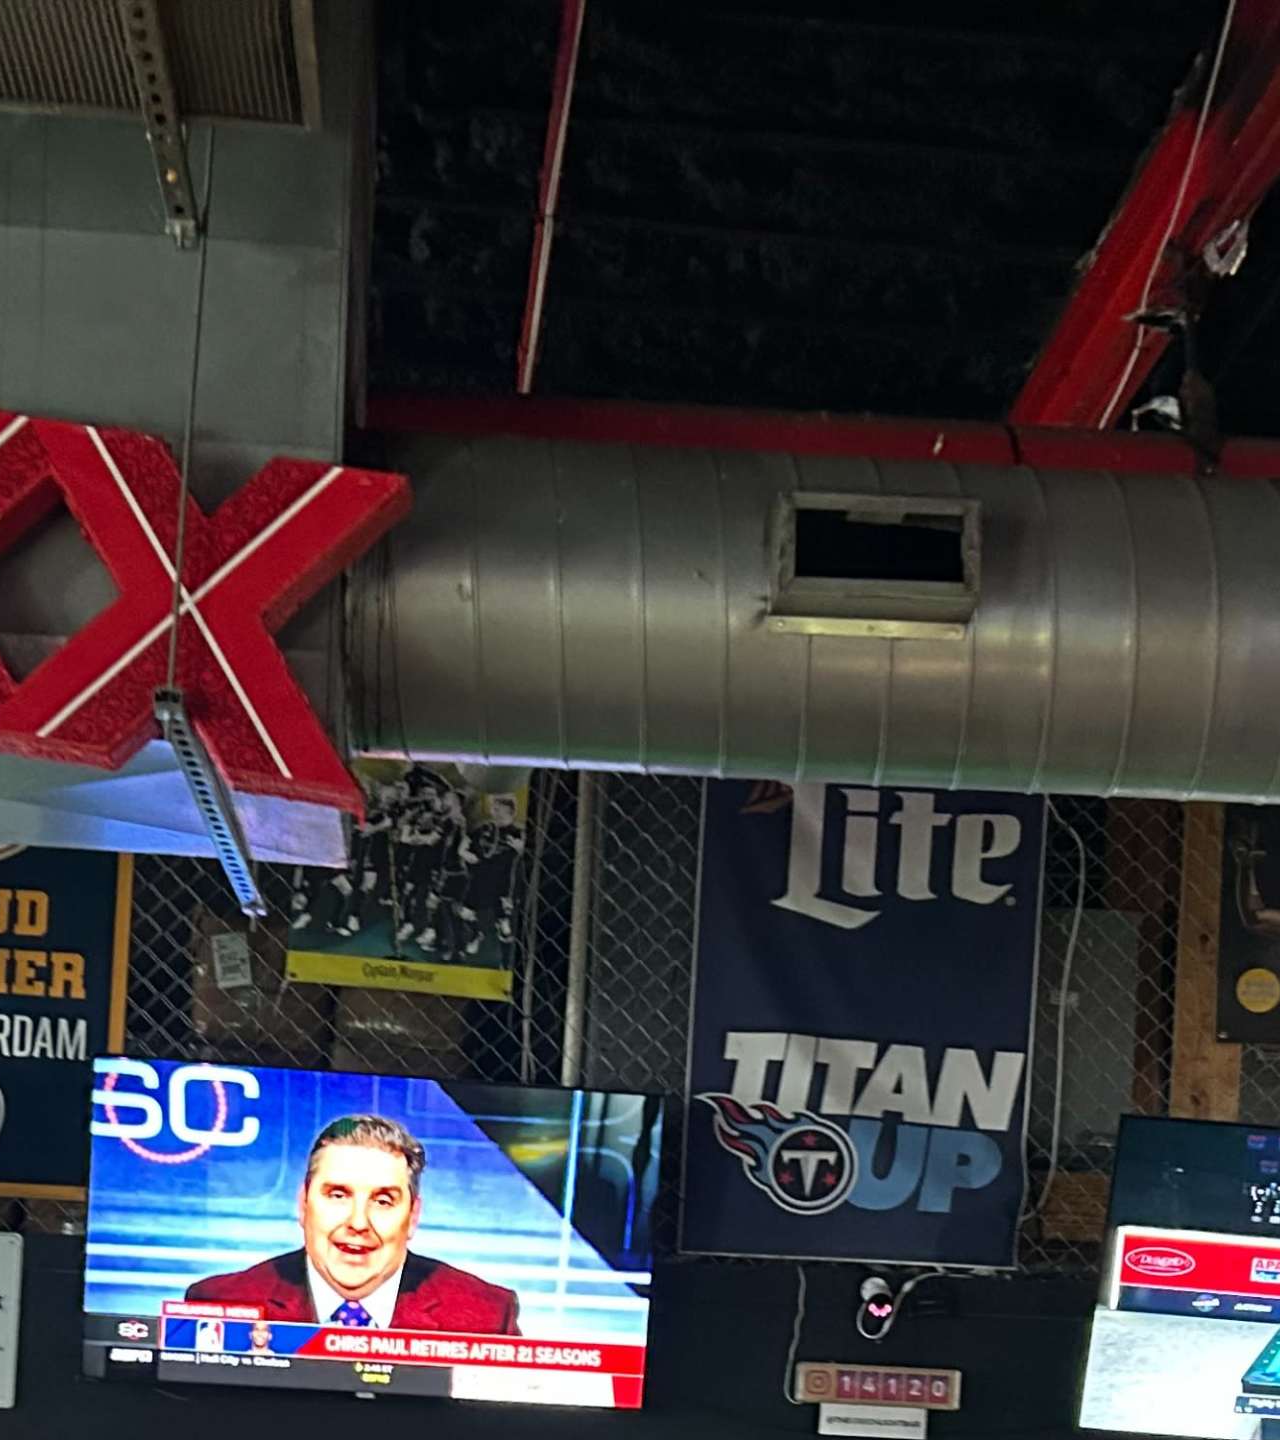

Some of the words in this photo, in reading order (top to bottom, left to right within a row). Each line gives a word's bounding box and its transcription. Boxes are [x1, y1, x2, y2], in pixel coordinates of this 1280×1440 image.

[770, 783, 1022, 930] Lite
[90, 1058, 261, 1147] SC
[723, 1032, 1025, 1131] TITAN
[847, 1117, 1004, 1213] UP
[325, 1333, 369, 1352] CHRIS
[369, 1336, 409, 1354] PAUL
[410, 1338, 470, 1358] RETIRES
[470, 1342, 516, 1362] AFTER
[535, 1346, 602, 1367] SEASONS
